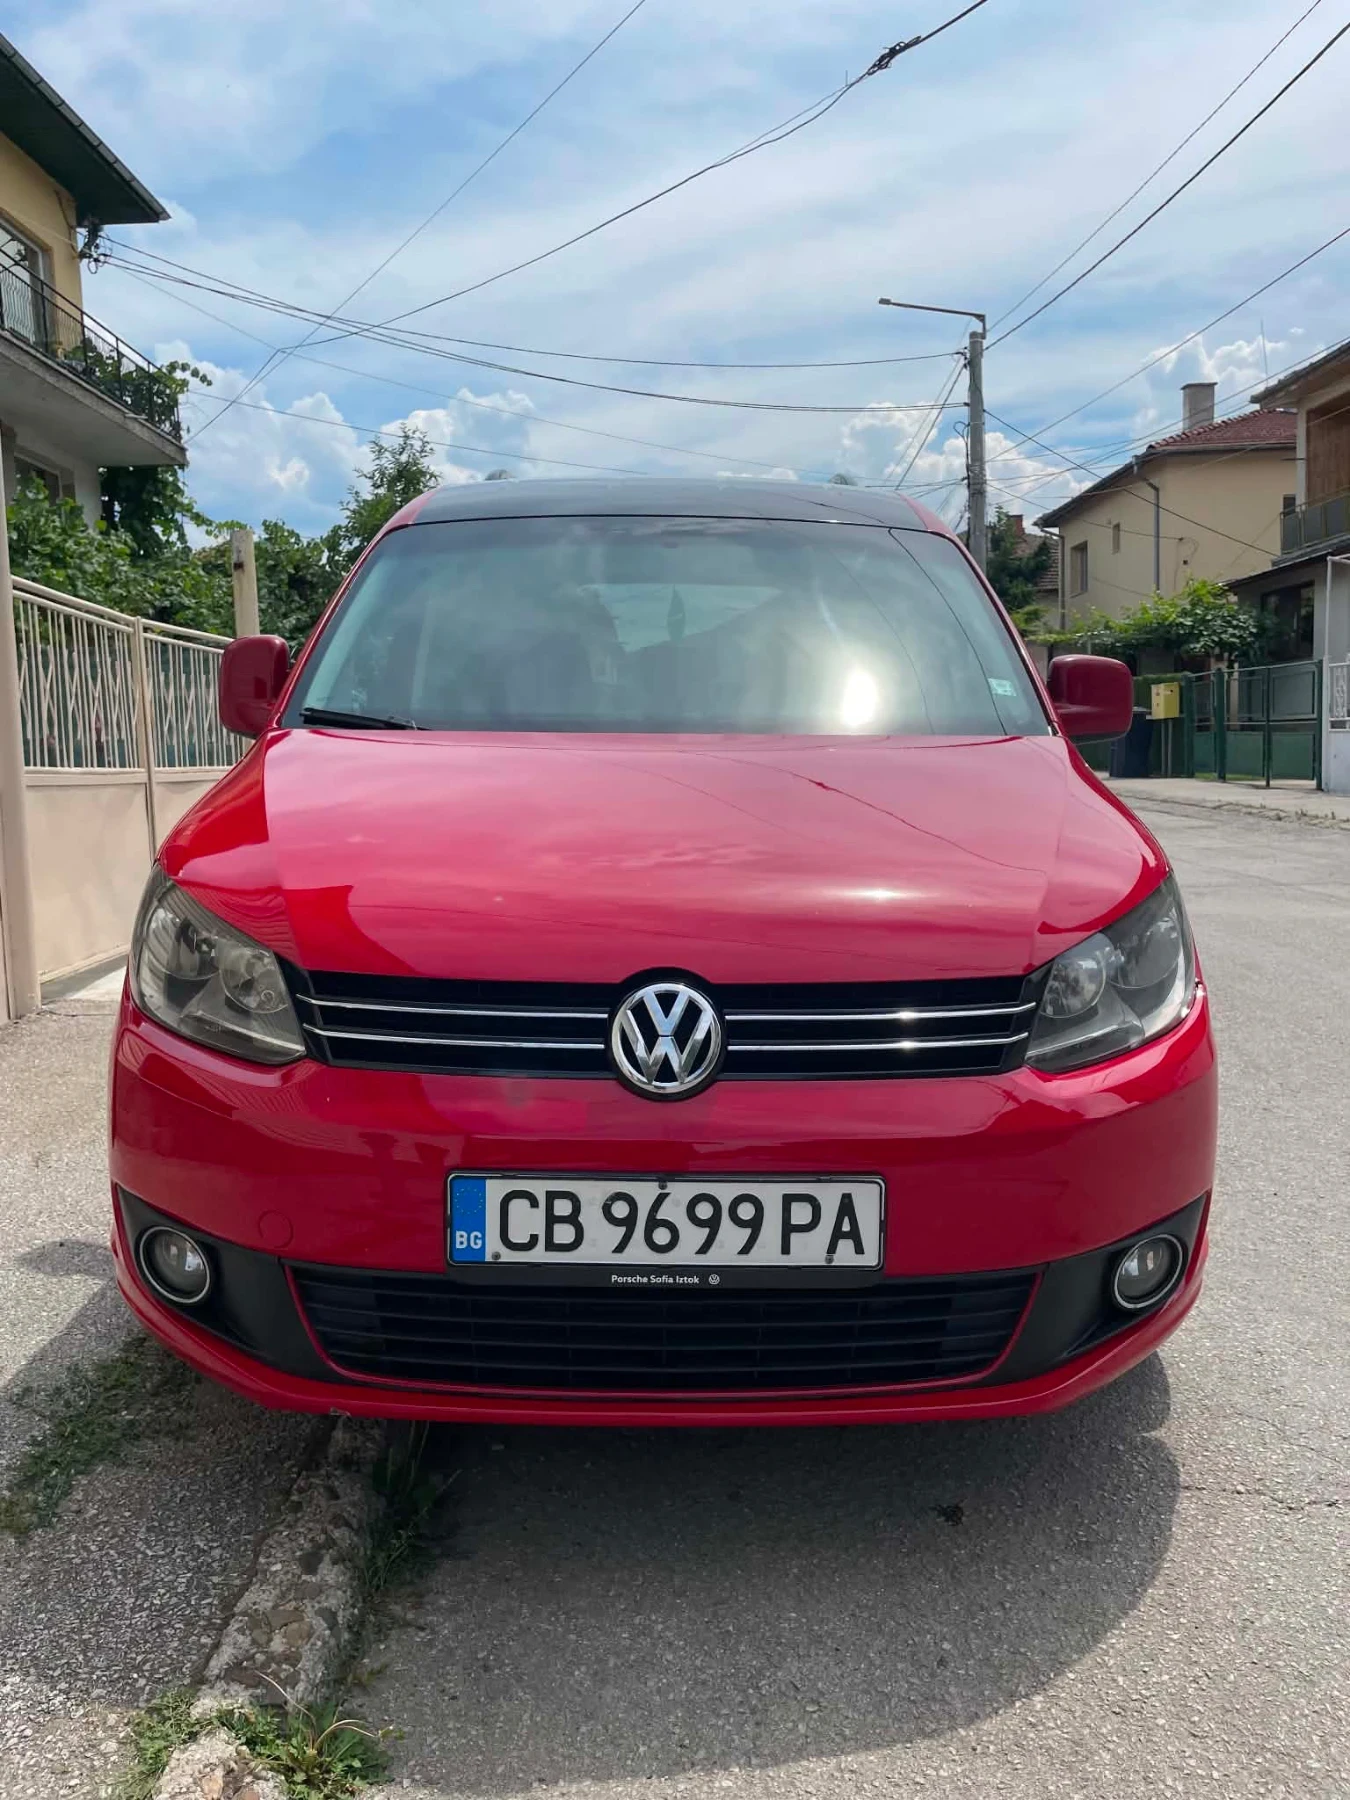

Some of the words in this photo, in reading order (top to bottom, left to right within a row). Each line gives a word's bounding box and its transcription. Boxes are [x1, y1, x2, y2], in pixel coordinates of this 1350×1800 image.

[499, 1189, 585, 1253] CB
[601, 1191, 765, 1255] 9699
[780, 1193, 865, 1255] PA
[455, 1231, 482, 1250] BG
[611, 1274, 648, 1283] Porsche
[650, 1274, 673, 1283] Sofia
[676, 1275, 700, 1284] Iztok
